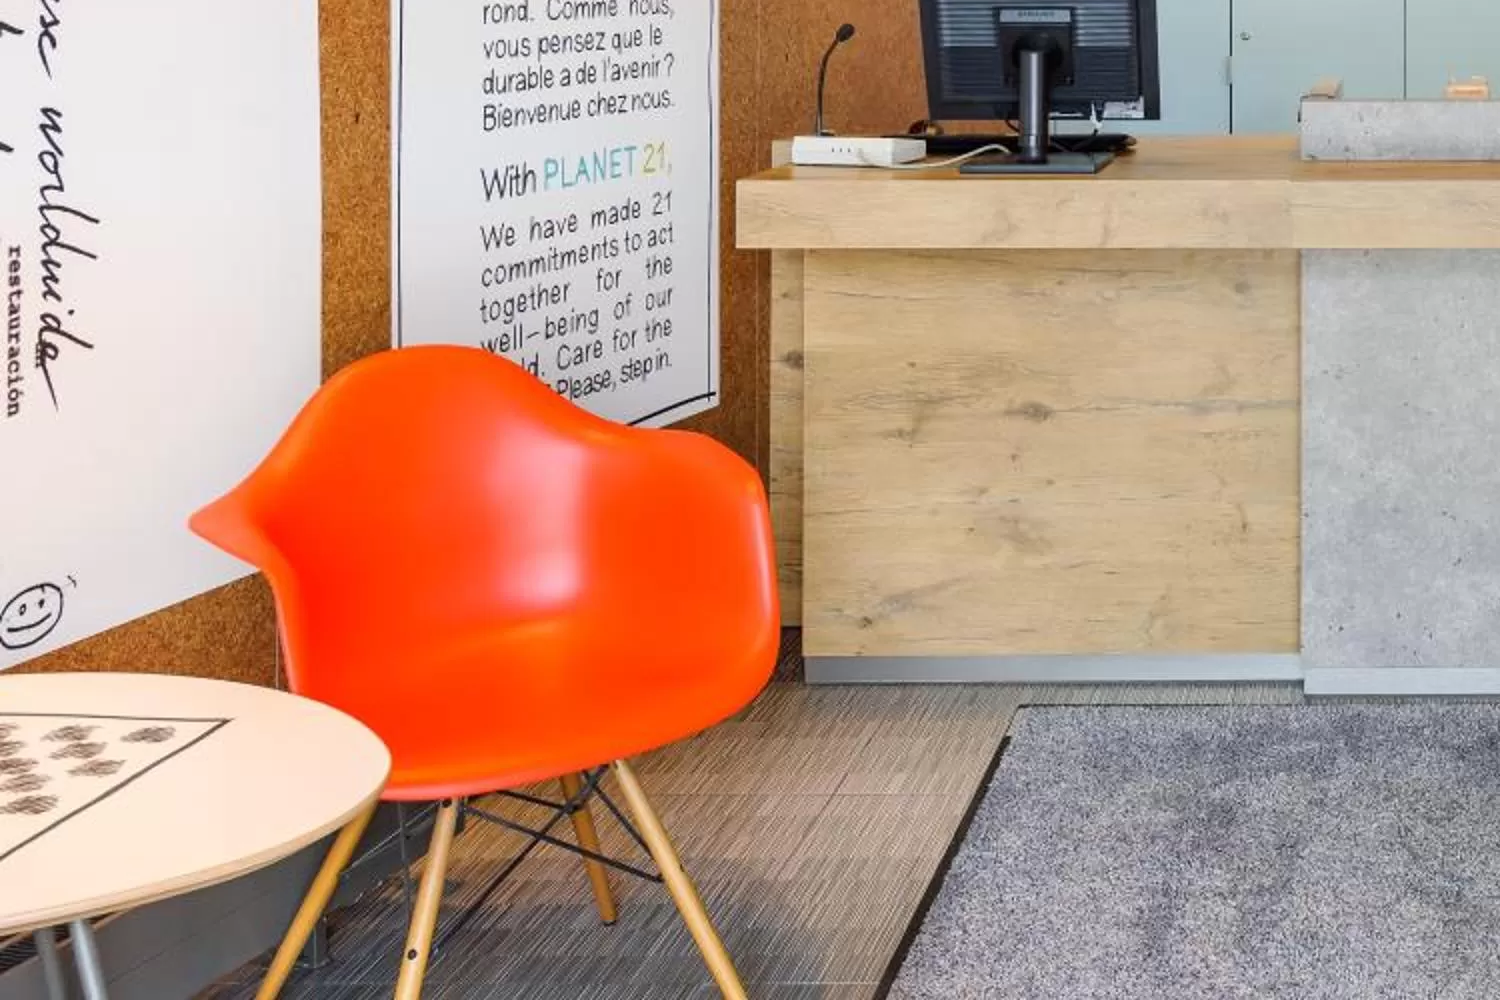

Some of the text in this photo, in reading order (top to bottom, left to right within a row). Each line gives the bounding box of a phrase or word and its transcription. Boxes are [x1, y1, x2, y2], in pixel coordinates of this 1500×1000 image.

[483, 24, 663, 62] vous pensez que le
[482, 65, 554, 95] durable
[575, 62, 597, 84] de
[482, 89, 675, 132] Bienvenue chez nous.
[480, 161, 537, 202] With
[543, 145, 637, 190] PLANET
[480, 190, 672, 252] We have made 21
[481, 222, 673, 288] commitments to act
[479, 255, 673, 325] together for the
[613, 293, 632, 320] of
[645, 287, 673, 311] our
[7, 245, 22, 417] restauración
[556, 339, 603, 370] Care
[613, 327, 637, 352] for
[645, 317, 673, 341] the
[620, 356, 653, 382] step
